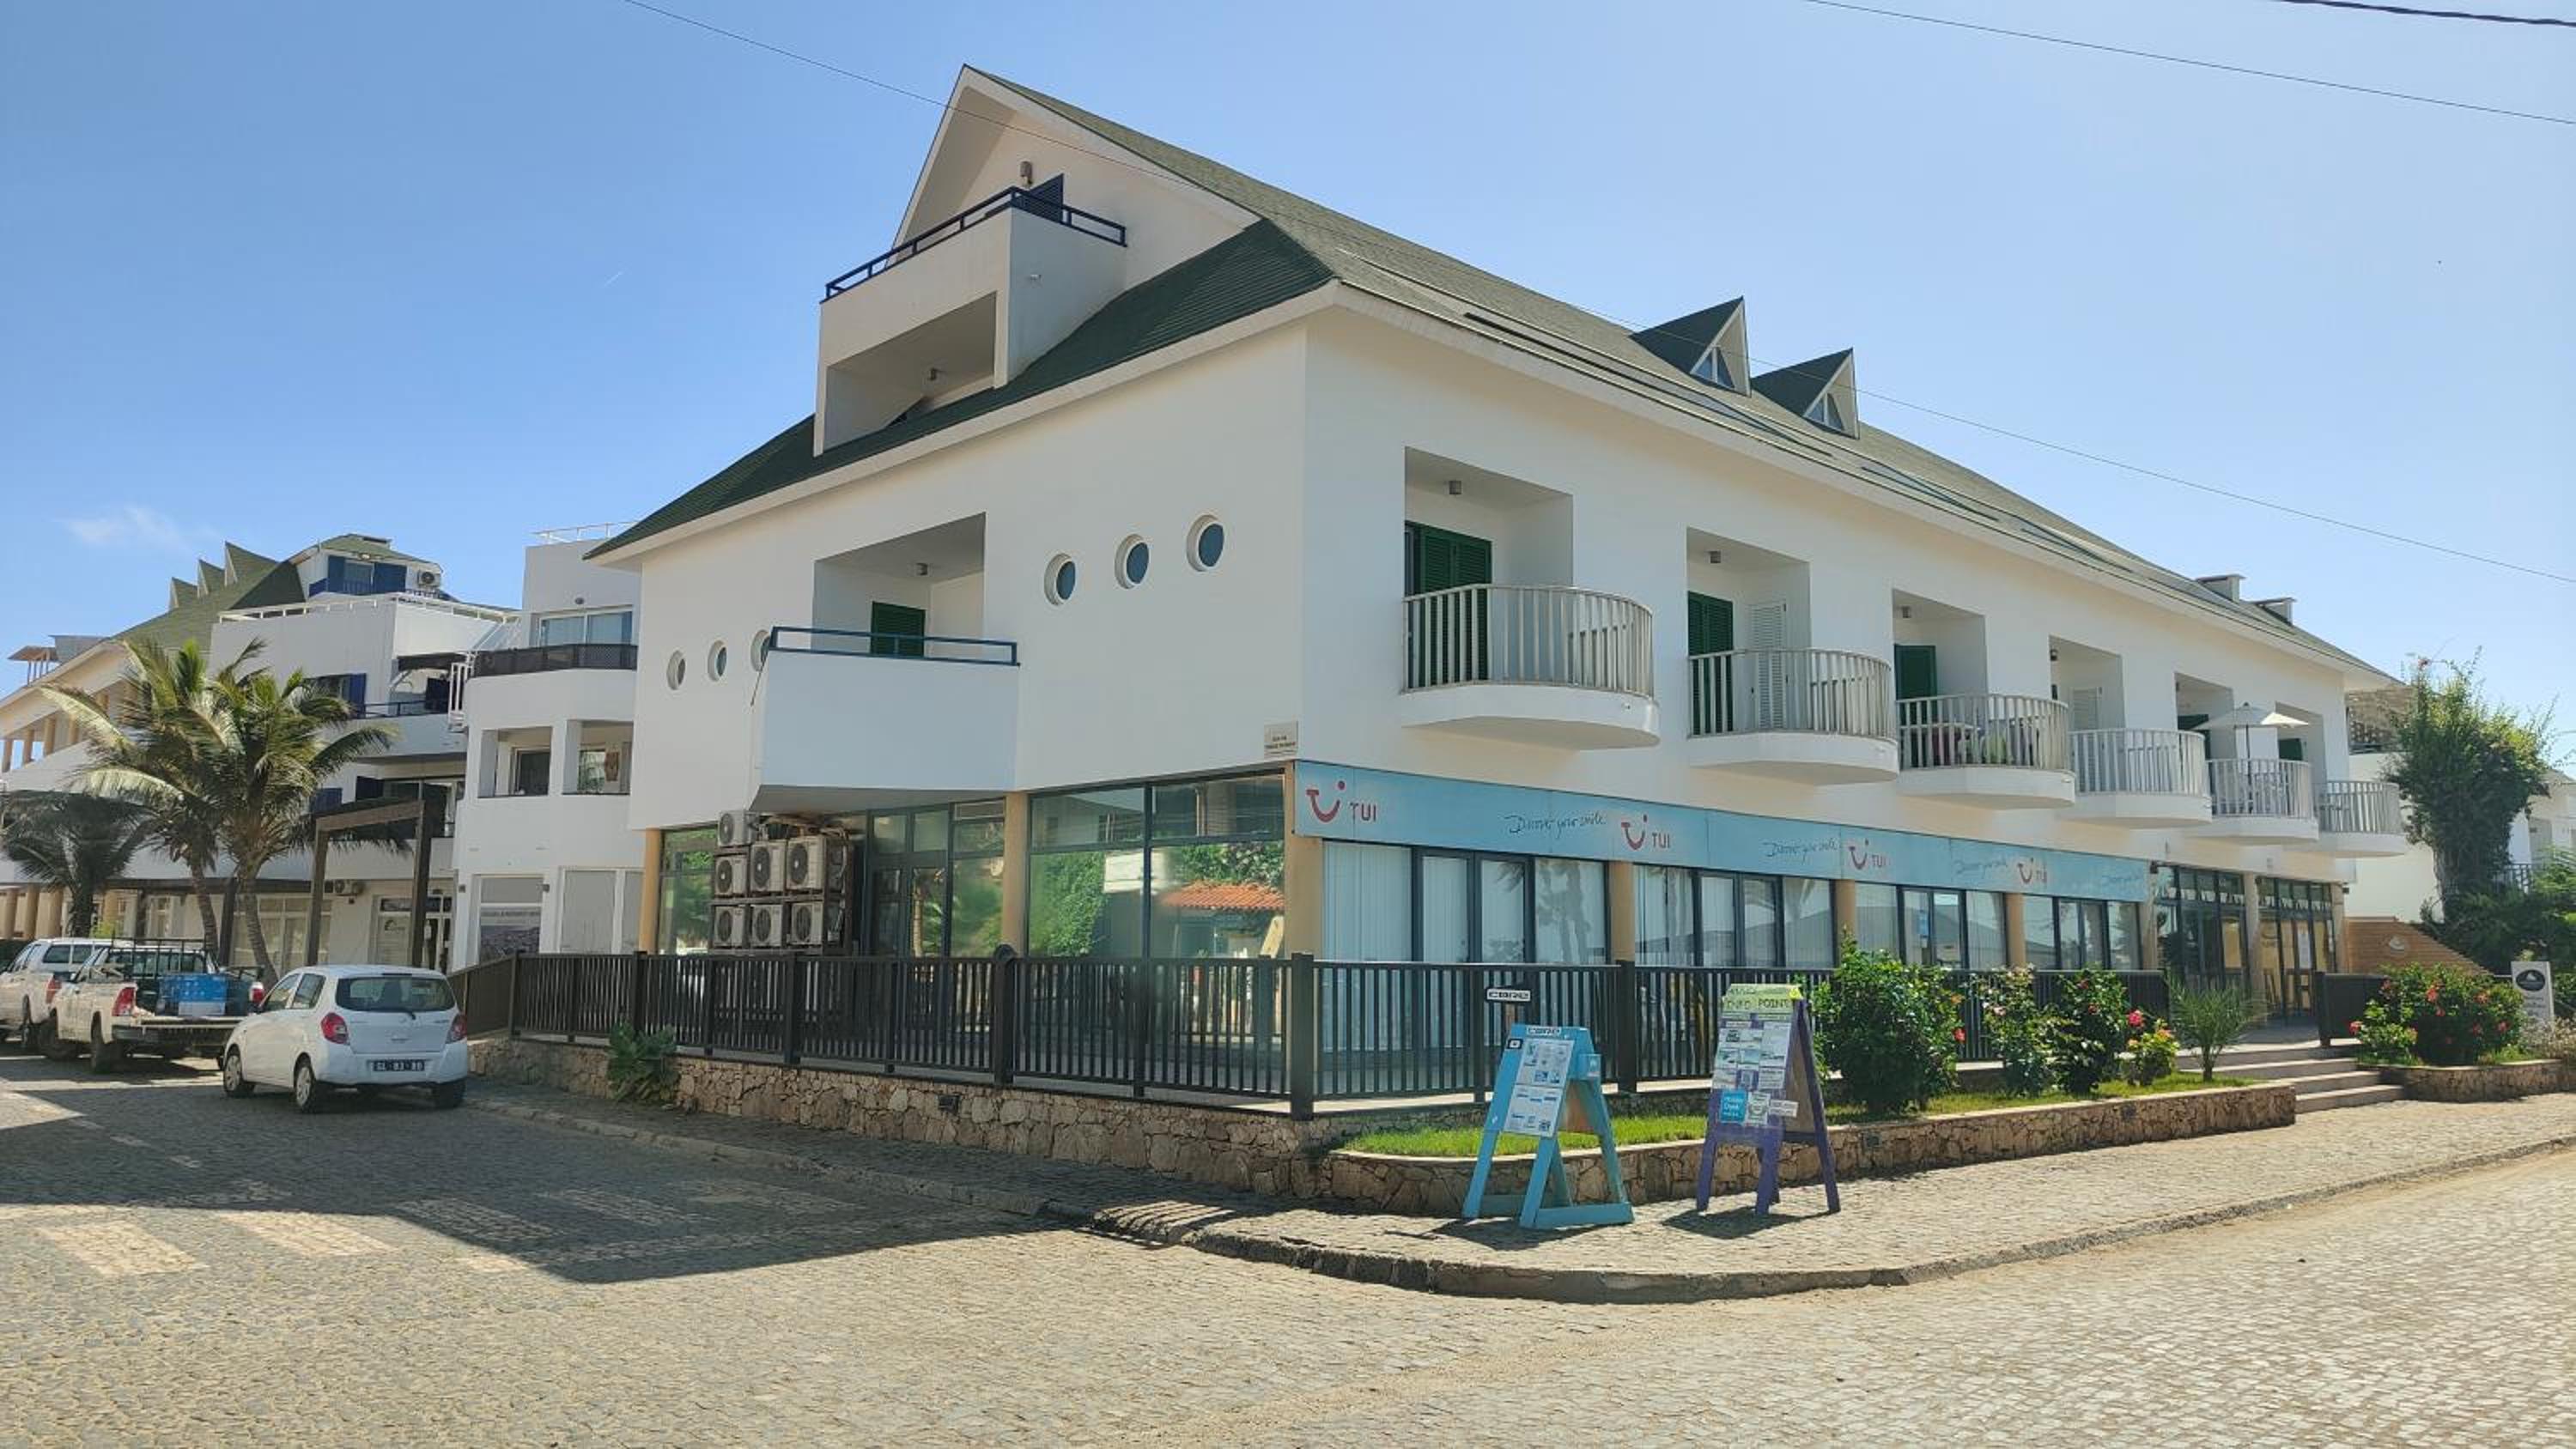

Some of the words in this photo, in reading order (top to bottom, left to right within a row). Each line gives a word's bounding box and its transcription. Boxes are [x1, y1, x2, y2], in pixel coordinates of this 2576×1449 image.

[1350, 802, 1377, 822] TUI
[1651, 832, 1671, 849] TUI
[1758, 997, 1789, 1008] POINT
